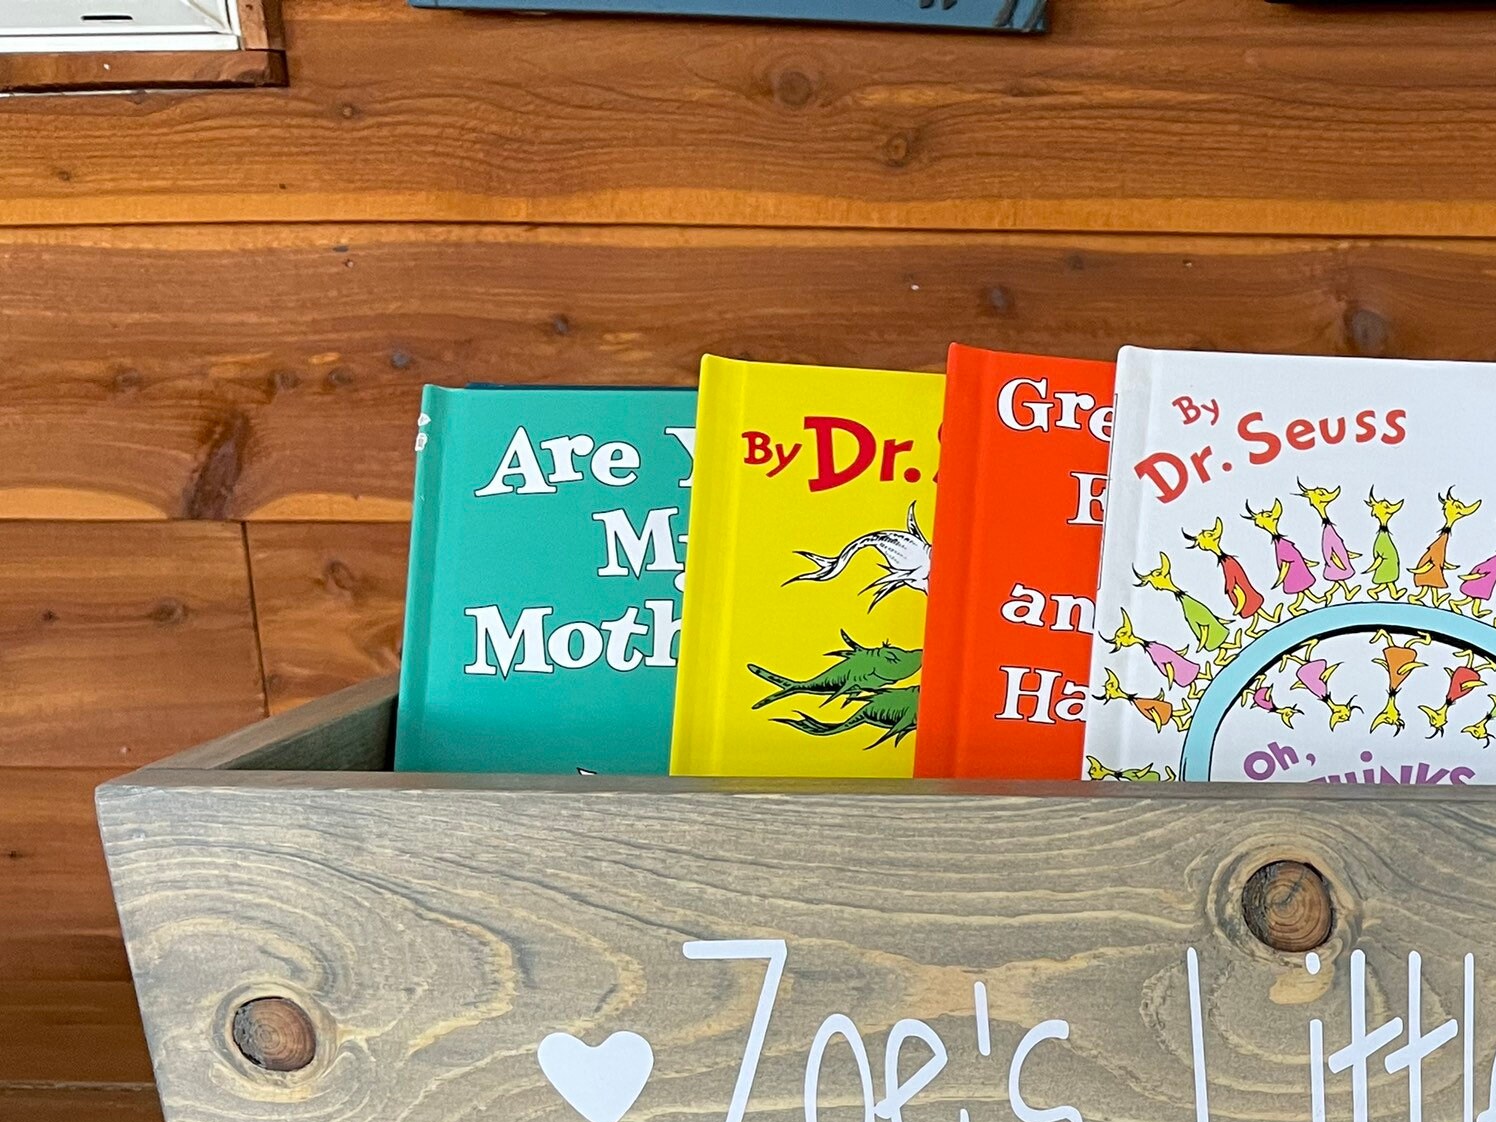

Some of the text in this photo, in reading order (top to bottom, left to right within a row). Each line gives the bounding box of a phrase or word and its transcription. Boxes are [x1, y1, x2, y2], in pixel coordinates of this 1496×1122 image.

[1171, 396, 1219, 425] By
[474, 425, 642, 497] Are
[741, 431, 802, 478] By
[804, 416, 921, 492] Dr.
[1134, 411, 1406, 503] Dr. Seuss
[592, 506, 690, 592] M
[1243, 741, 1316, 781] Oh,
